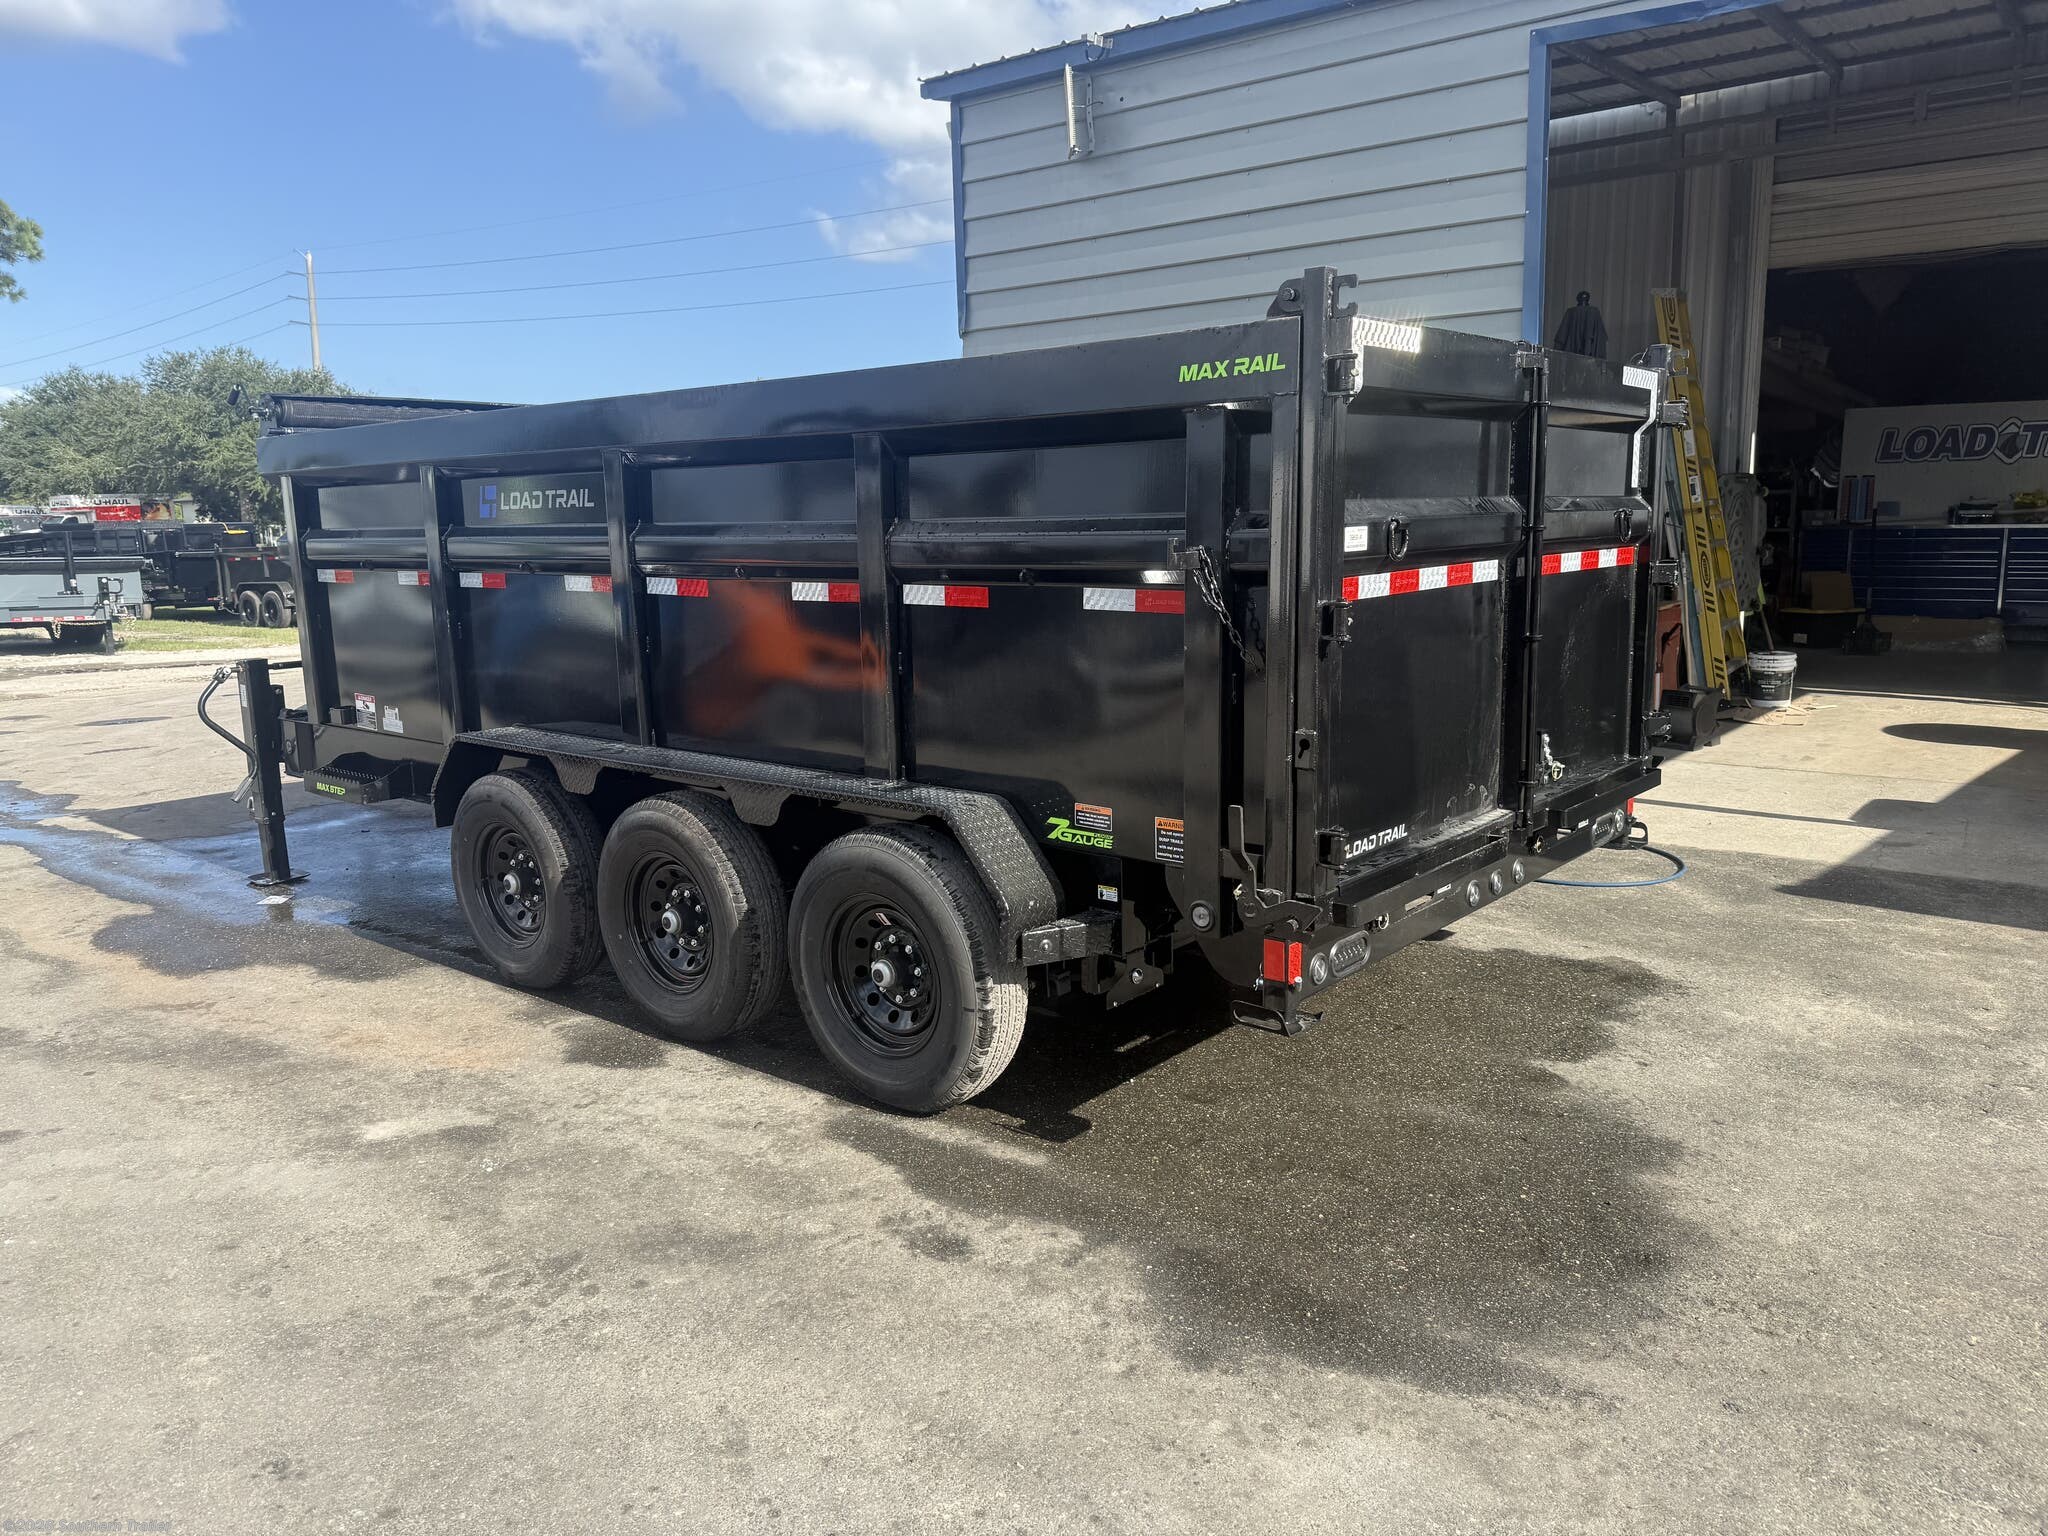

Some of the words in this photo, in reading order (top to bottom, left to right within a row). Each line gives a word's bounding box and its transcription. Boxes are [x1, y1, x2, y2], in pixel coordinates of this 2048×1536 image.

[1178, 359, 1230, 382] MAX
[1233, 352, 1286, 376] RAIL
[1875, 422, 1999, 464] LOAD
[2020, 418, 2048, 460] T
[500, 491, 543, 510] LOAD
[545, 488, 595, 508] TRAIL
[316, 782, 330, 793] MAX
[330, 785, 346, 796] STEP
[1045, 816, 1070, 839] 7
[1057, 828, 1114, 849] GAUGE
[1344, 835, 1377, 859] LOAD
[1378, 824, 1408, 846] TRAIL
